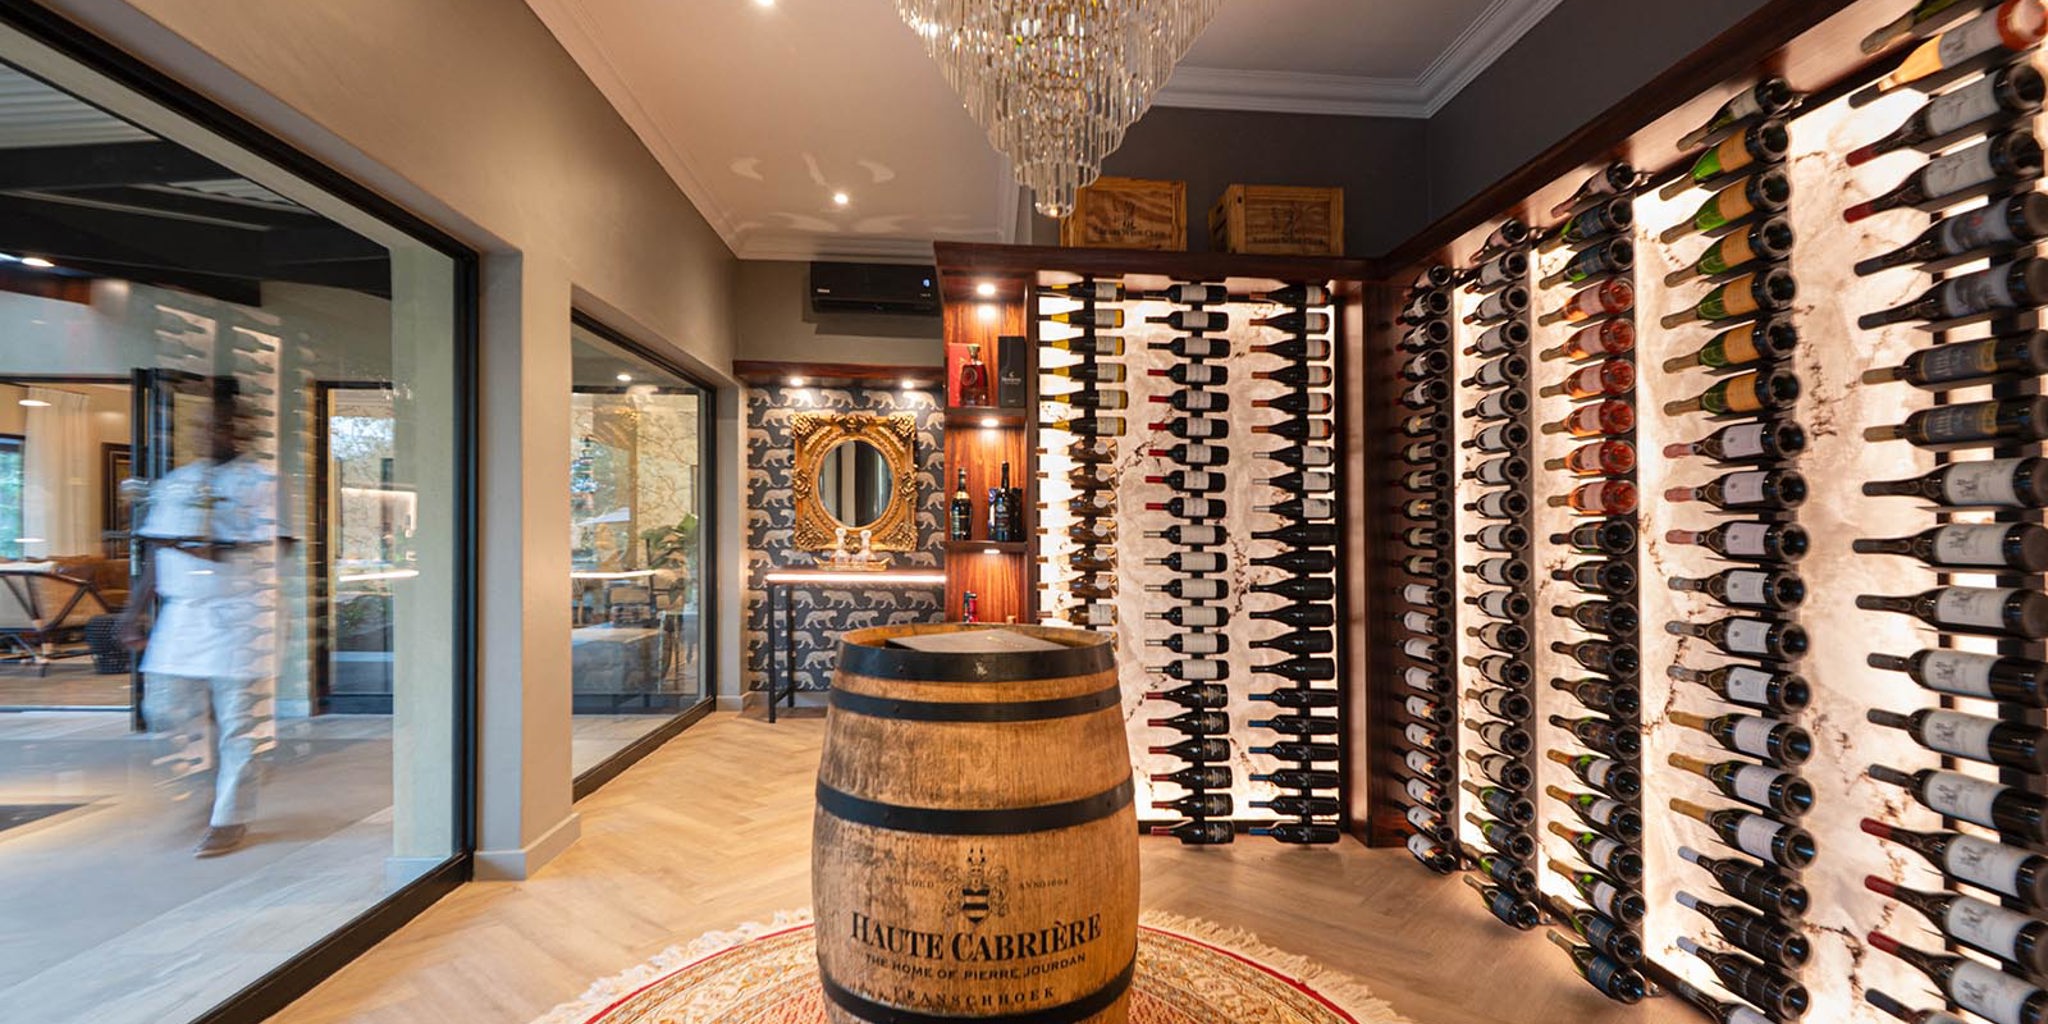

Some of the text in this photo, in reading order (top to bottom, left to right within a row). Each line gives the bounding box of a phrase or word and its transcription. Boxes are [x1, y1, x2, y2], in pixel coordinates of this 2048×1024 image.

[850, 911, 1101, 962] HAUTE CABRIÈRE
[865, 953, 1086, 981] THE HOME OF PIERRE JOURDAN
